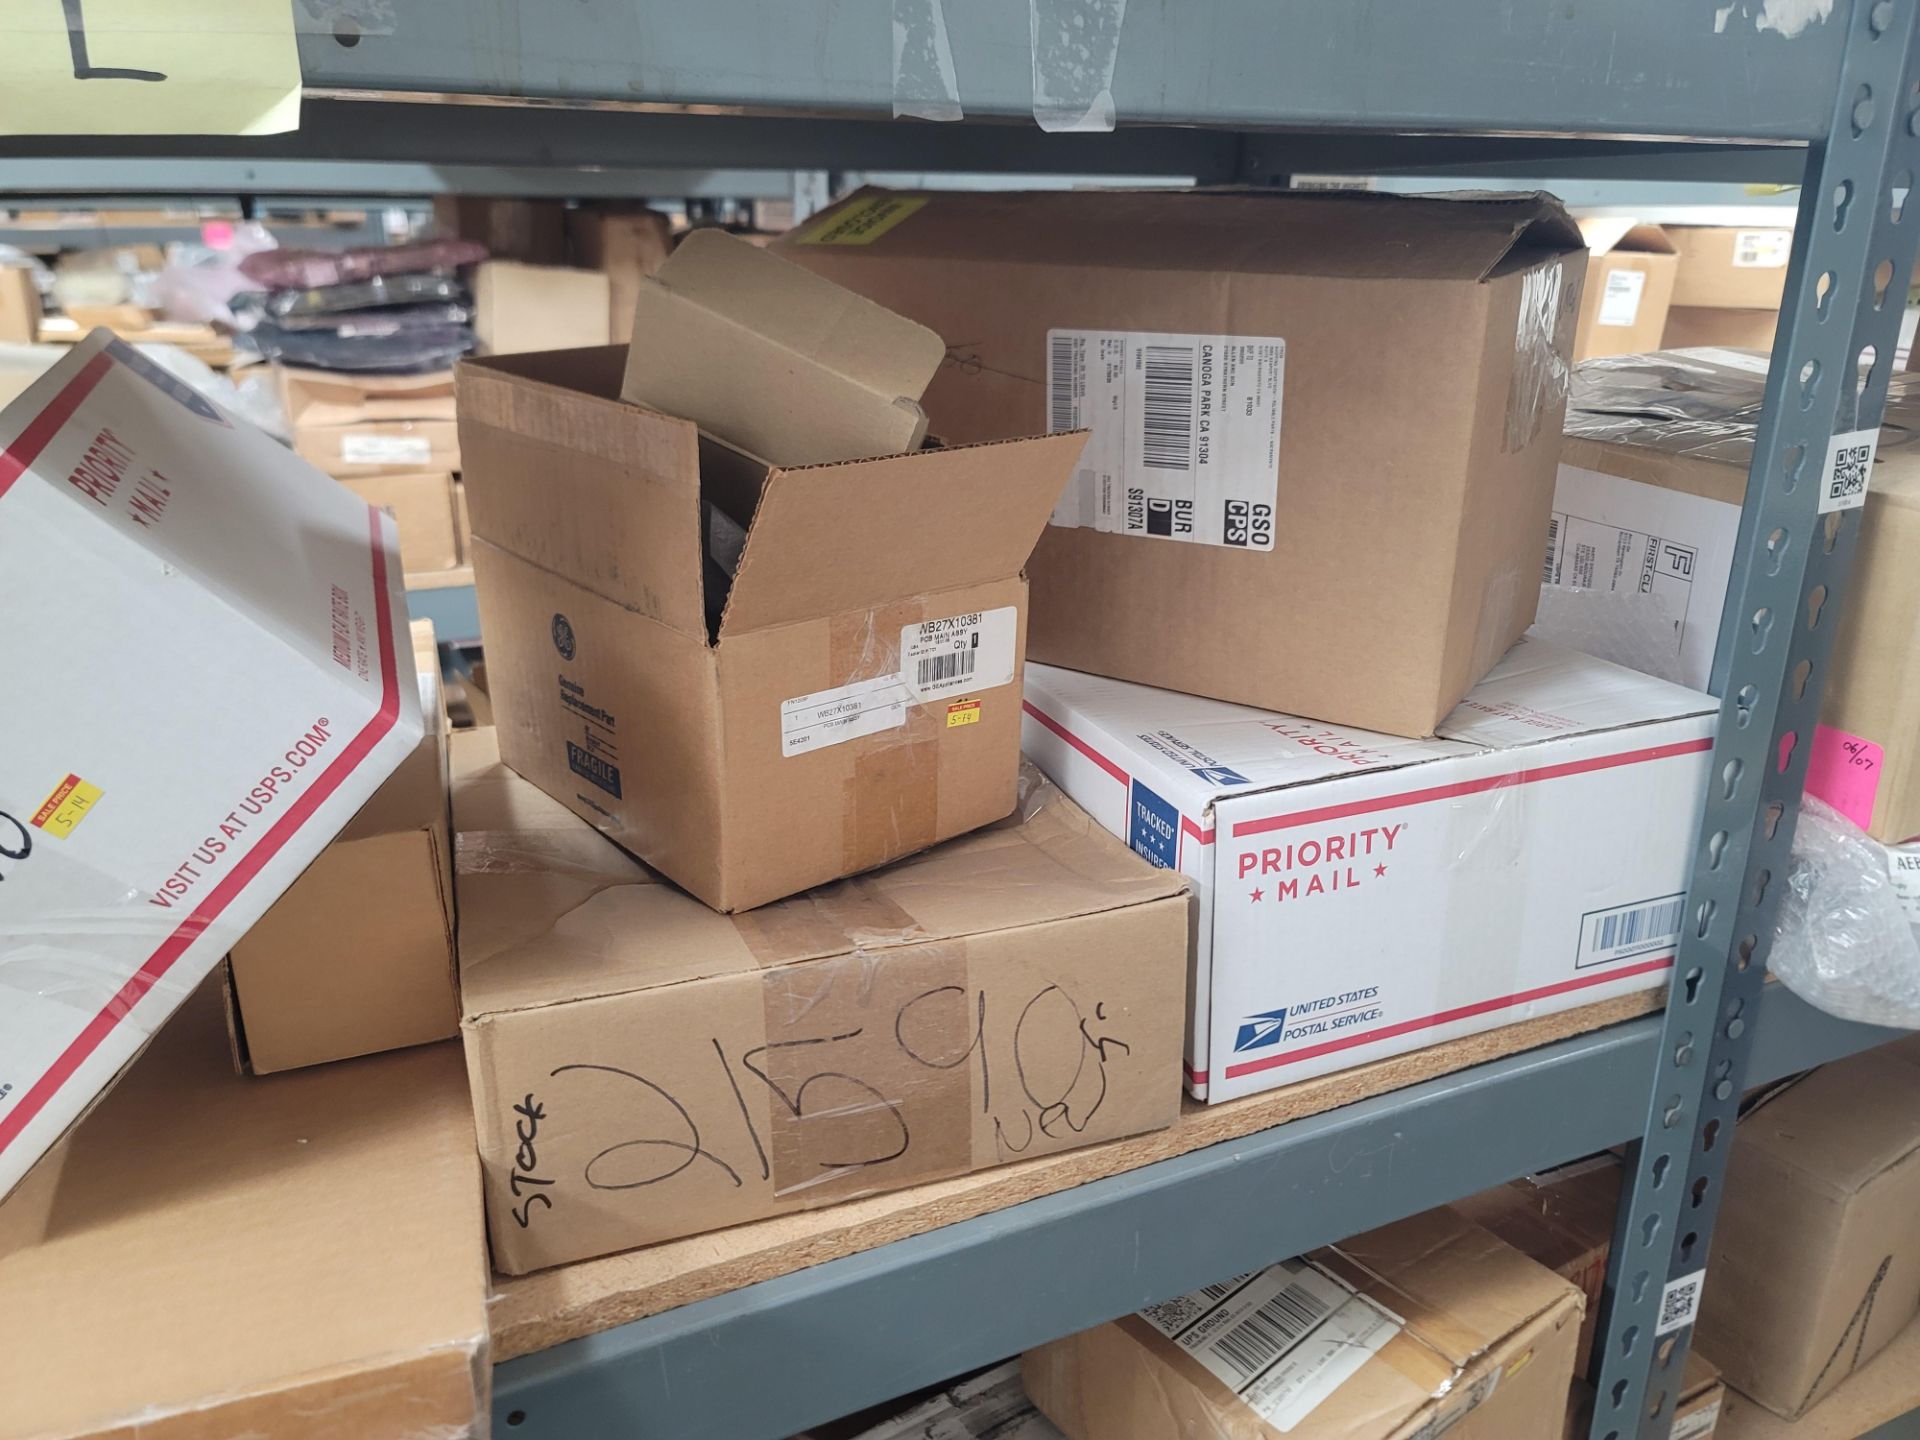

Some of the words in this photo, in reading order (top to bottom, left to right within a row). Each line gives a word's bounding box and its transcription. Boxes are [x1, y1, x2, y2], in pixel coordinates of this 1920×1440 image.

[1201, 345, 1212, 386] CANOGA
[1200, 390, 1210, 416] PARK
[1200, 421, 1209, 432] CA
[1199, 436, 1208, 464] 91304
[67, 427, 136, 507] PRIORITY
[127, 477, 172, 524] MAIL
[1127, 488, 1143, 529] S91307A
[1149, 499, 1170, 512] D
[1175, 500, 1192, 533] BUR
[1227, 501, 1247, 542] CPS
[1252, 504, 1271, 545] GSO
[1664, 545, 1693, 575] F
[920, 634, 932, 643] PCB
[934, 632, 950, 640] MAIN
[954, 640, 967, 649] Qty
[601, 710, 615, 727] Part
[817, 702, 861, 718] WB27X10381
[1265, 721, 1378, 765] PRIORITY
[1323, 731, 1377, 754] MAIL
[571, 747, 614, 784] FRAGILE
[38, 802, 56, 821] SALE
[53, 784, 73, 804] PRICE
[149, 863, 202, 909] VISIT
[197, 835, 228, 865] US
[218, 811, 249, 841] AT
[1238, 823, 1401, 880] PRIORITY
[1277, 870, 1361, 902] MAIL
[1290, 996, 1332, 1018] UNITED
[1335, 986, 1380, 1009] STATES
[1283, 1018, 1328, 1042] POSTAL
[512, 1092, 556, 1229] STOCK
[1181, 1330, 1200, 1347] UPS
[1198, 1309, 1230, 1334] GROUND
